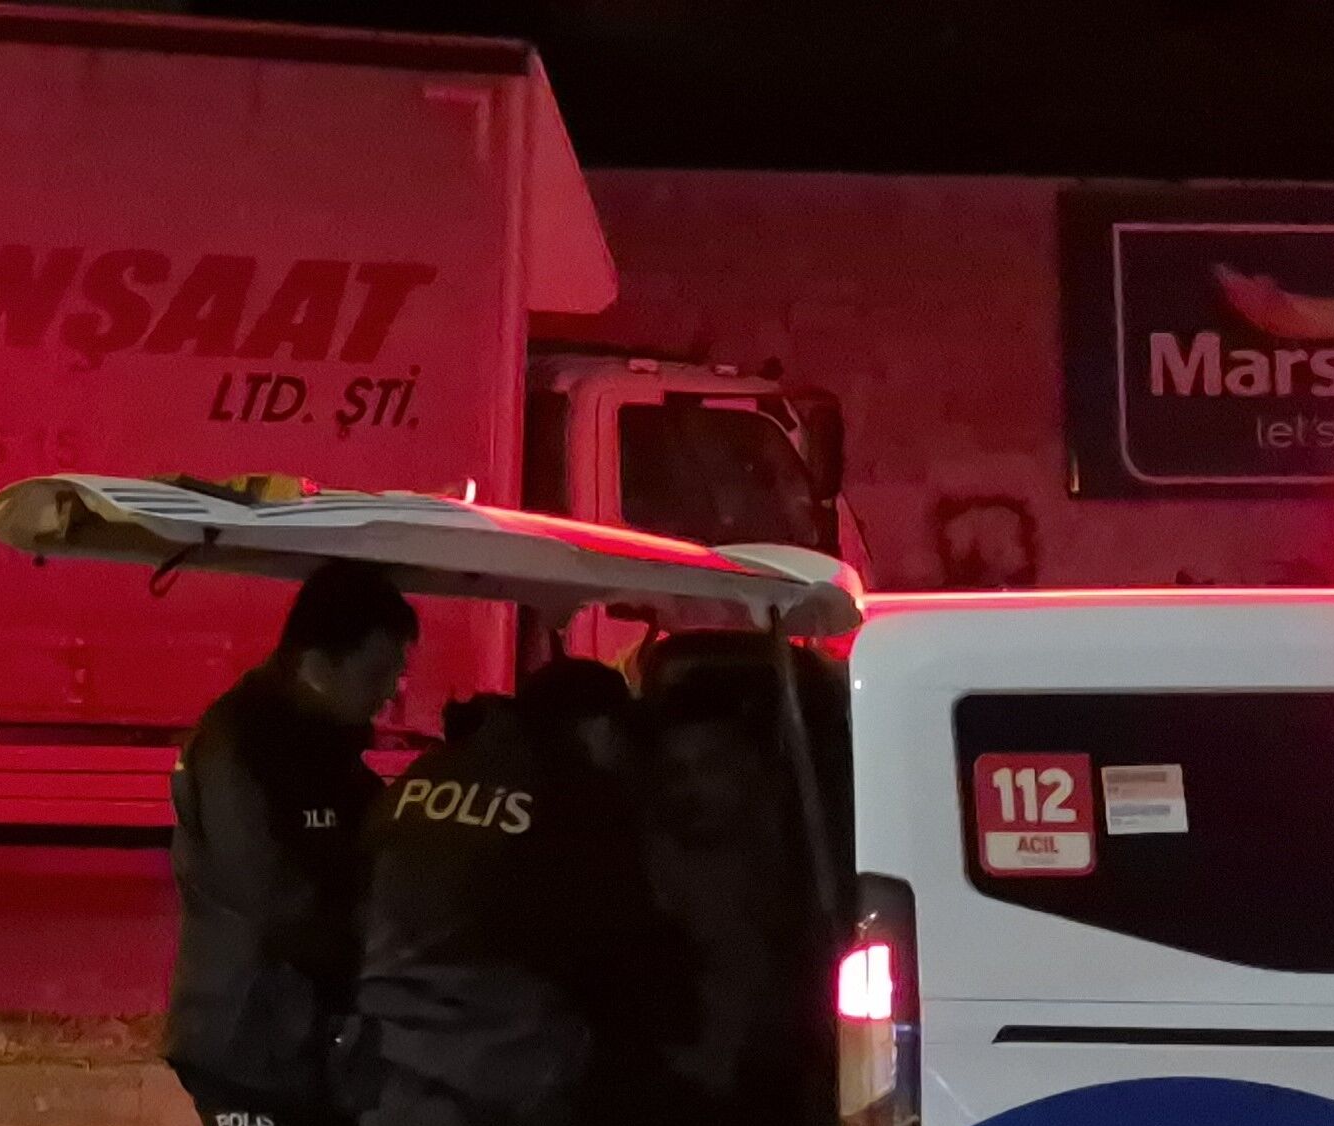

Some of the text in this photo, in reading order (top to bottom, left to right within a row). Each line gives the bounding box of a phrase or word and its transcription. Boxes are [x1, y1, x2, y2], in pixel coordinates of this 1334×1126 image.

[208, 364, 420, 439] LTD. ŞTİ.
[393, 778, 535, 834] POLİS
[992, 767, 1077, 824] 112
